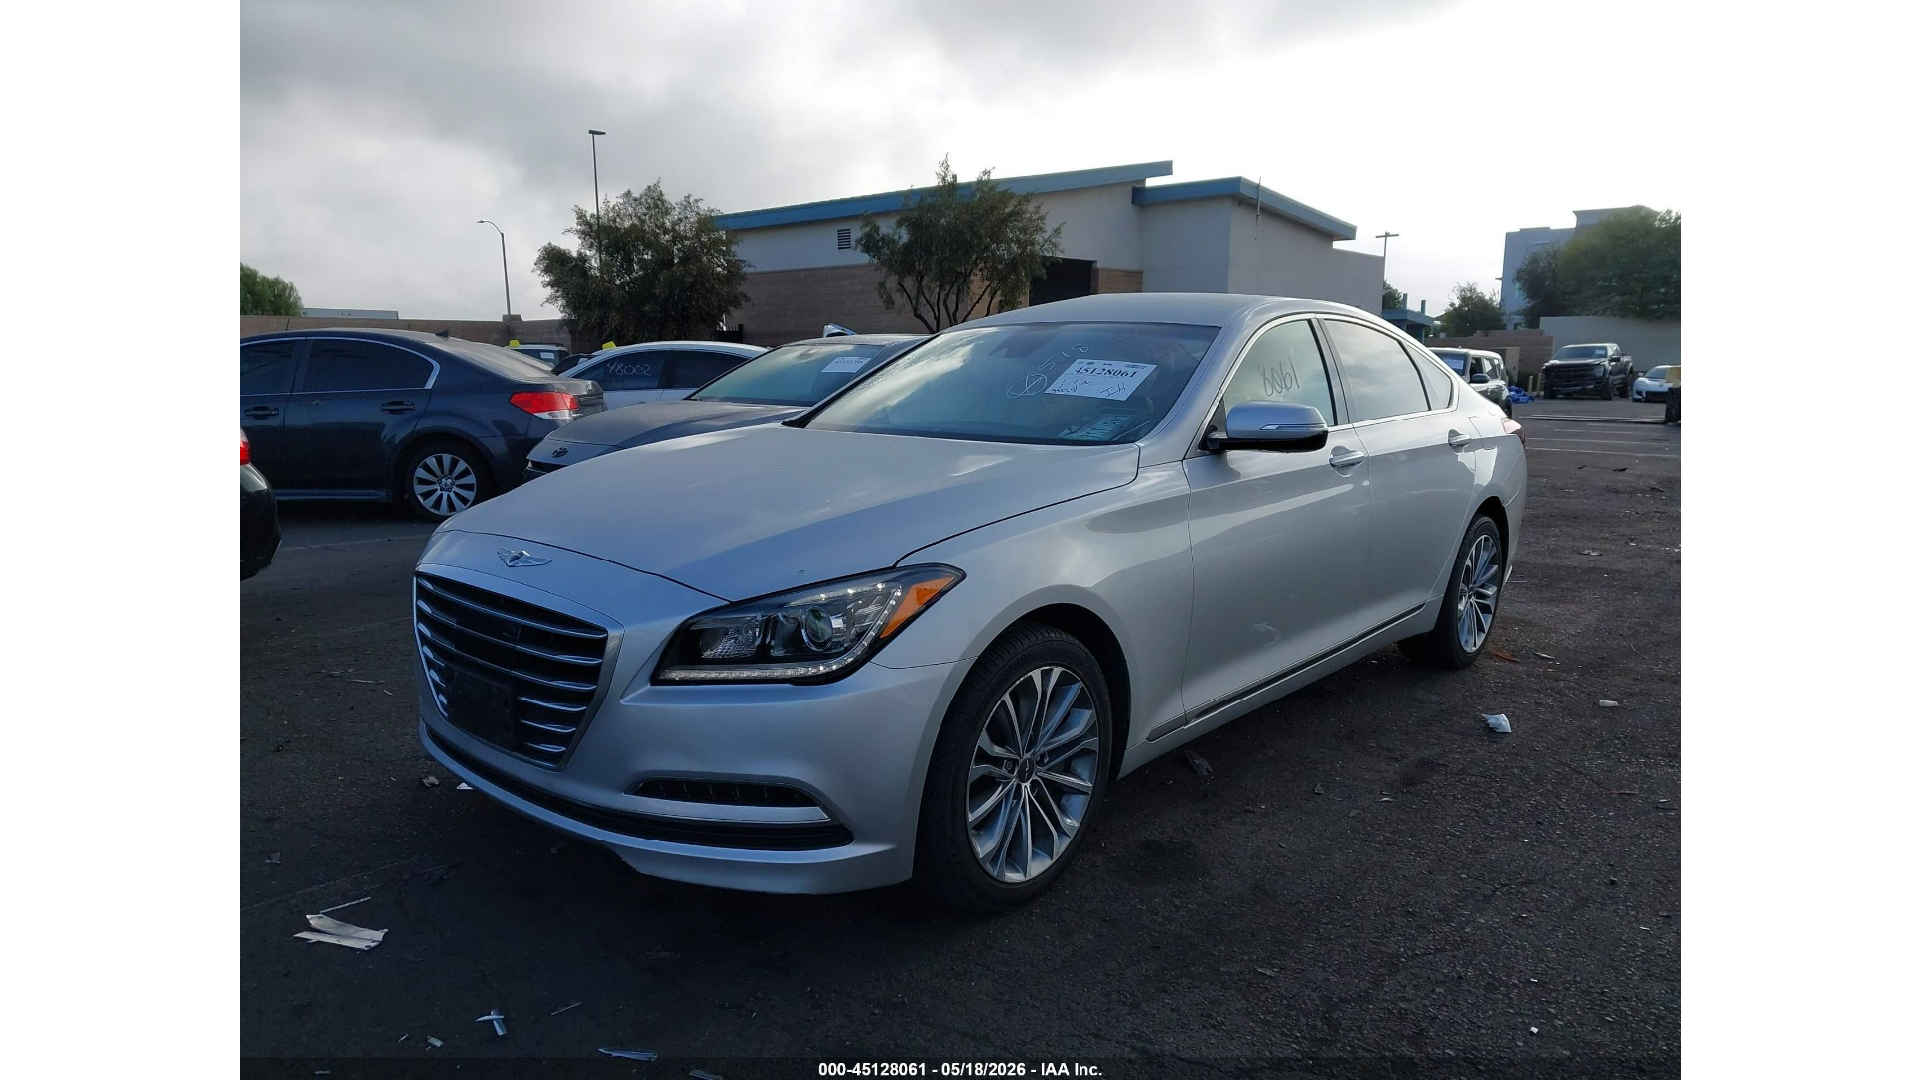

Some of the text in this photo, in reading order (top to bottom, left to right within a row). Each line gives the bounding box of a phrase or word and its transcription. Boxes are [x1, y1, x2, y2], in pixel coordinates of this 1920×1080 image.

[606, 361, 652, 377] 48002
[1074, 366, 1138, 378] 45128061
[1257, 357, 1300, 397] 8061
